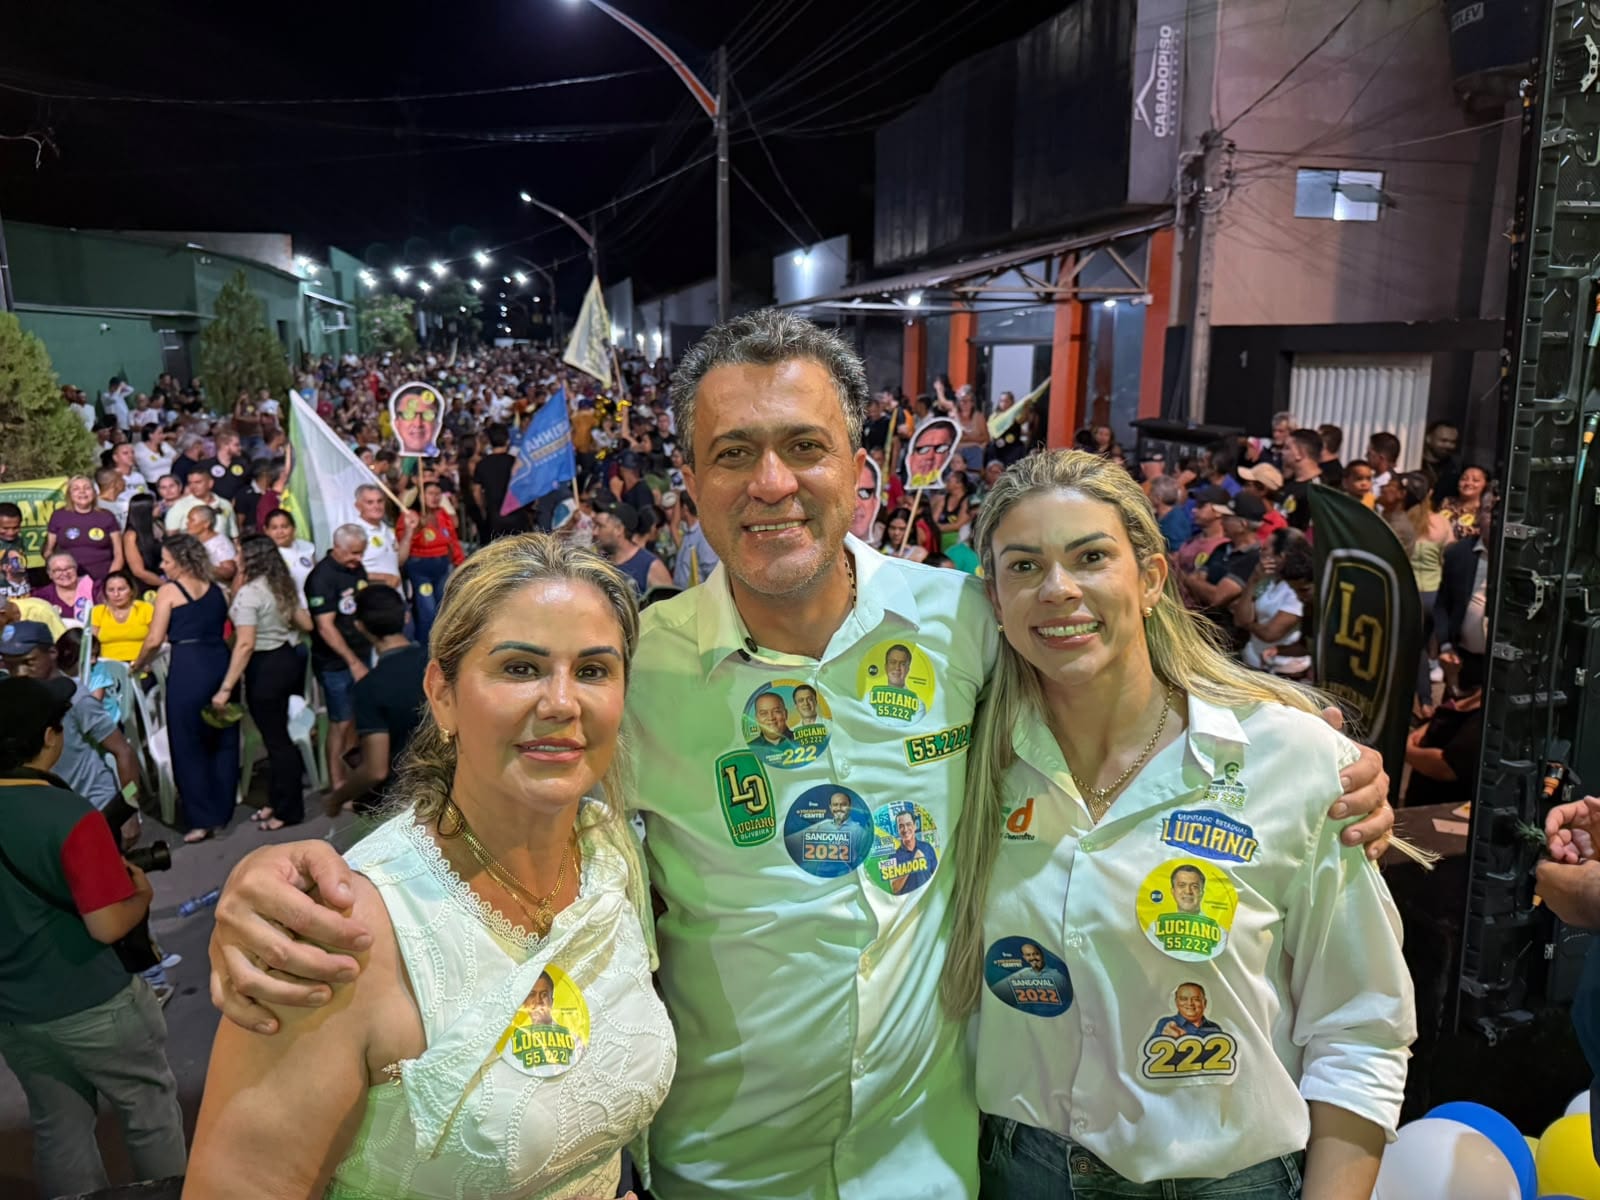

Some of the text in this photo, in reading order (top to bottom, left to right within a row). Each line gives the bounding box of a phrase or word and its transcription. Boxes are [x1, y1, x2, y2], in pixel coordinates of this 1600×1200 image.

[1154, 24, 1172, 137] CASADOPISO
[870, 691, 919, 711] LUCIANO
[878, 705, 910, 720] 55.222
[793, 726, 828, 740] LUCIANO
[911, 724, 968, 761] 55.222
[782, 745, 817, 766] 222
[724, 765, 768, 813] LO
[731, 816, 775, 837] LUCIANO
[805, 832, 850, 842] SANDOVAL
[1160, 818, 1259, 863] LUCIANO
[804, 844, 849, 860] 2022
[881, 857, 928, 880] SENADOR
[1155, 919, 1221, 941] LUCIANO
[1166, 937, 1209, 953] 55.222
[1015, 988, 1059, 1003] 2022
[512, 1031, 575, 1055] LUCIANO
[1149, 1036, 1231, 1073] 222
